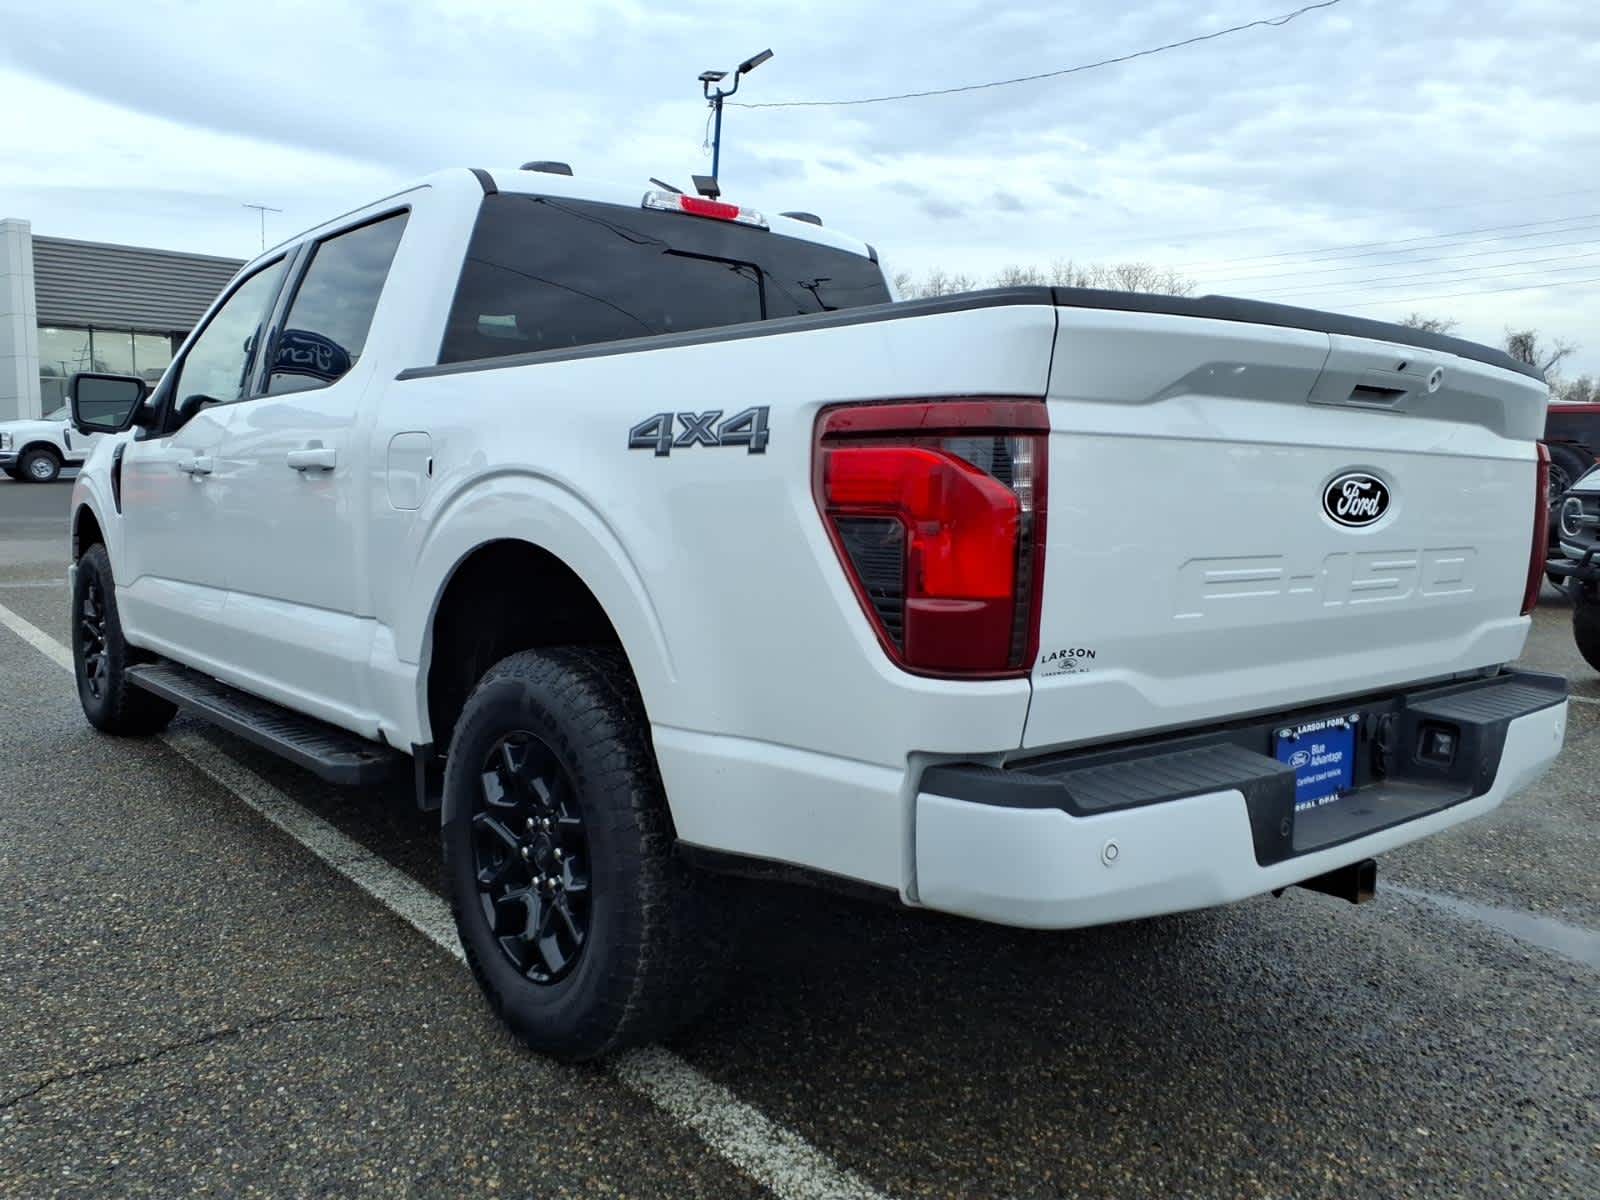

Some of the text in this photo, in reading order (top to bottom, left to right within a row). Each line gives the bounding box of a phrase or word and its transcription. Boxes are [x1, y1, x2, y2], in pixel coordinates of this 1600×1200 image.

[1336, 480, 1381, 515] Ford
[1173, 547, 1478, 618] F-150
[1041, 648, 1096, 664] LARSON
[1298, 723, 1326, 734] LARSON
